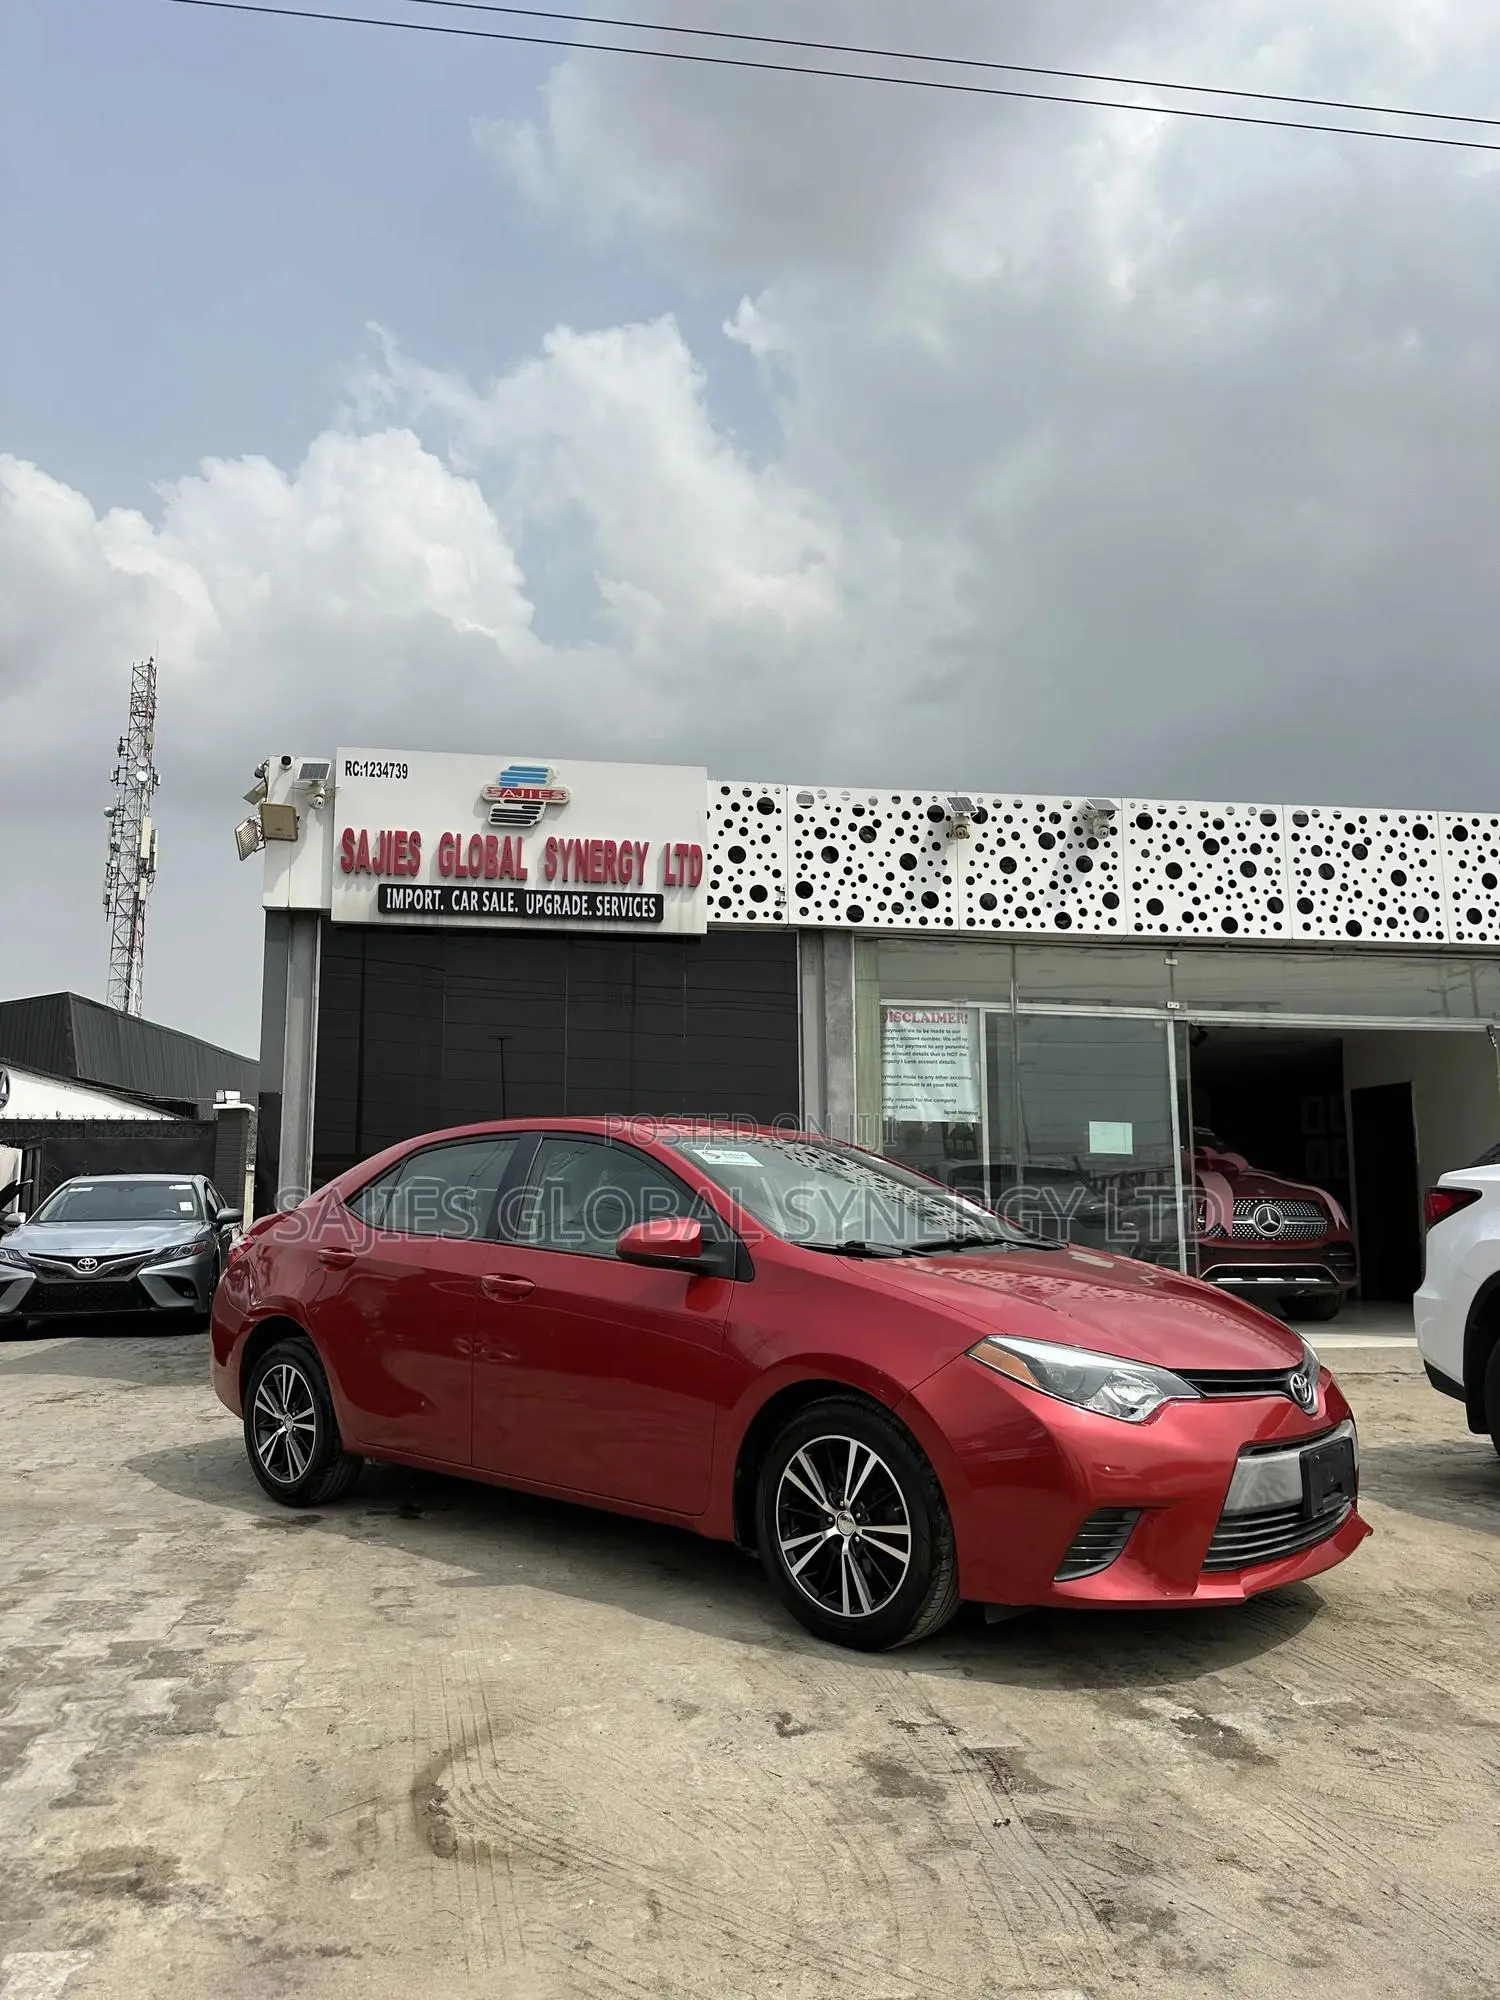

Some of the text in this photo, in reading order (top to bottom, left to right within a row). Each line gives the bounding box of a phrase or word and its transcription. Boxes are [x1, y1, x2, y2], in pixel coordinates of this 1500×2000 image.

[345, 760, 408, 779] RC:1234739
[487, 787, 567, 799] SAJIES
[340, 827, 703, 887] SAJIES GLOBAL SYNERGY LTD
[386, 887, 656, 918] IMPORT. CAR SALE. UPGRADE. SERVICES
